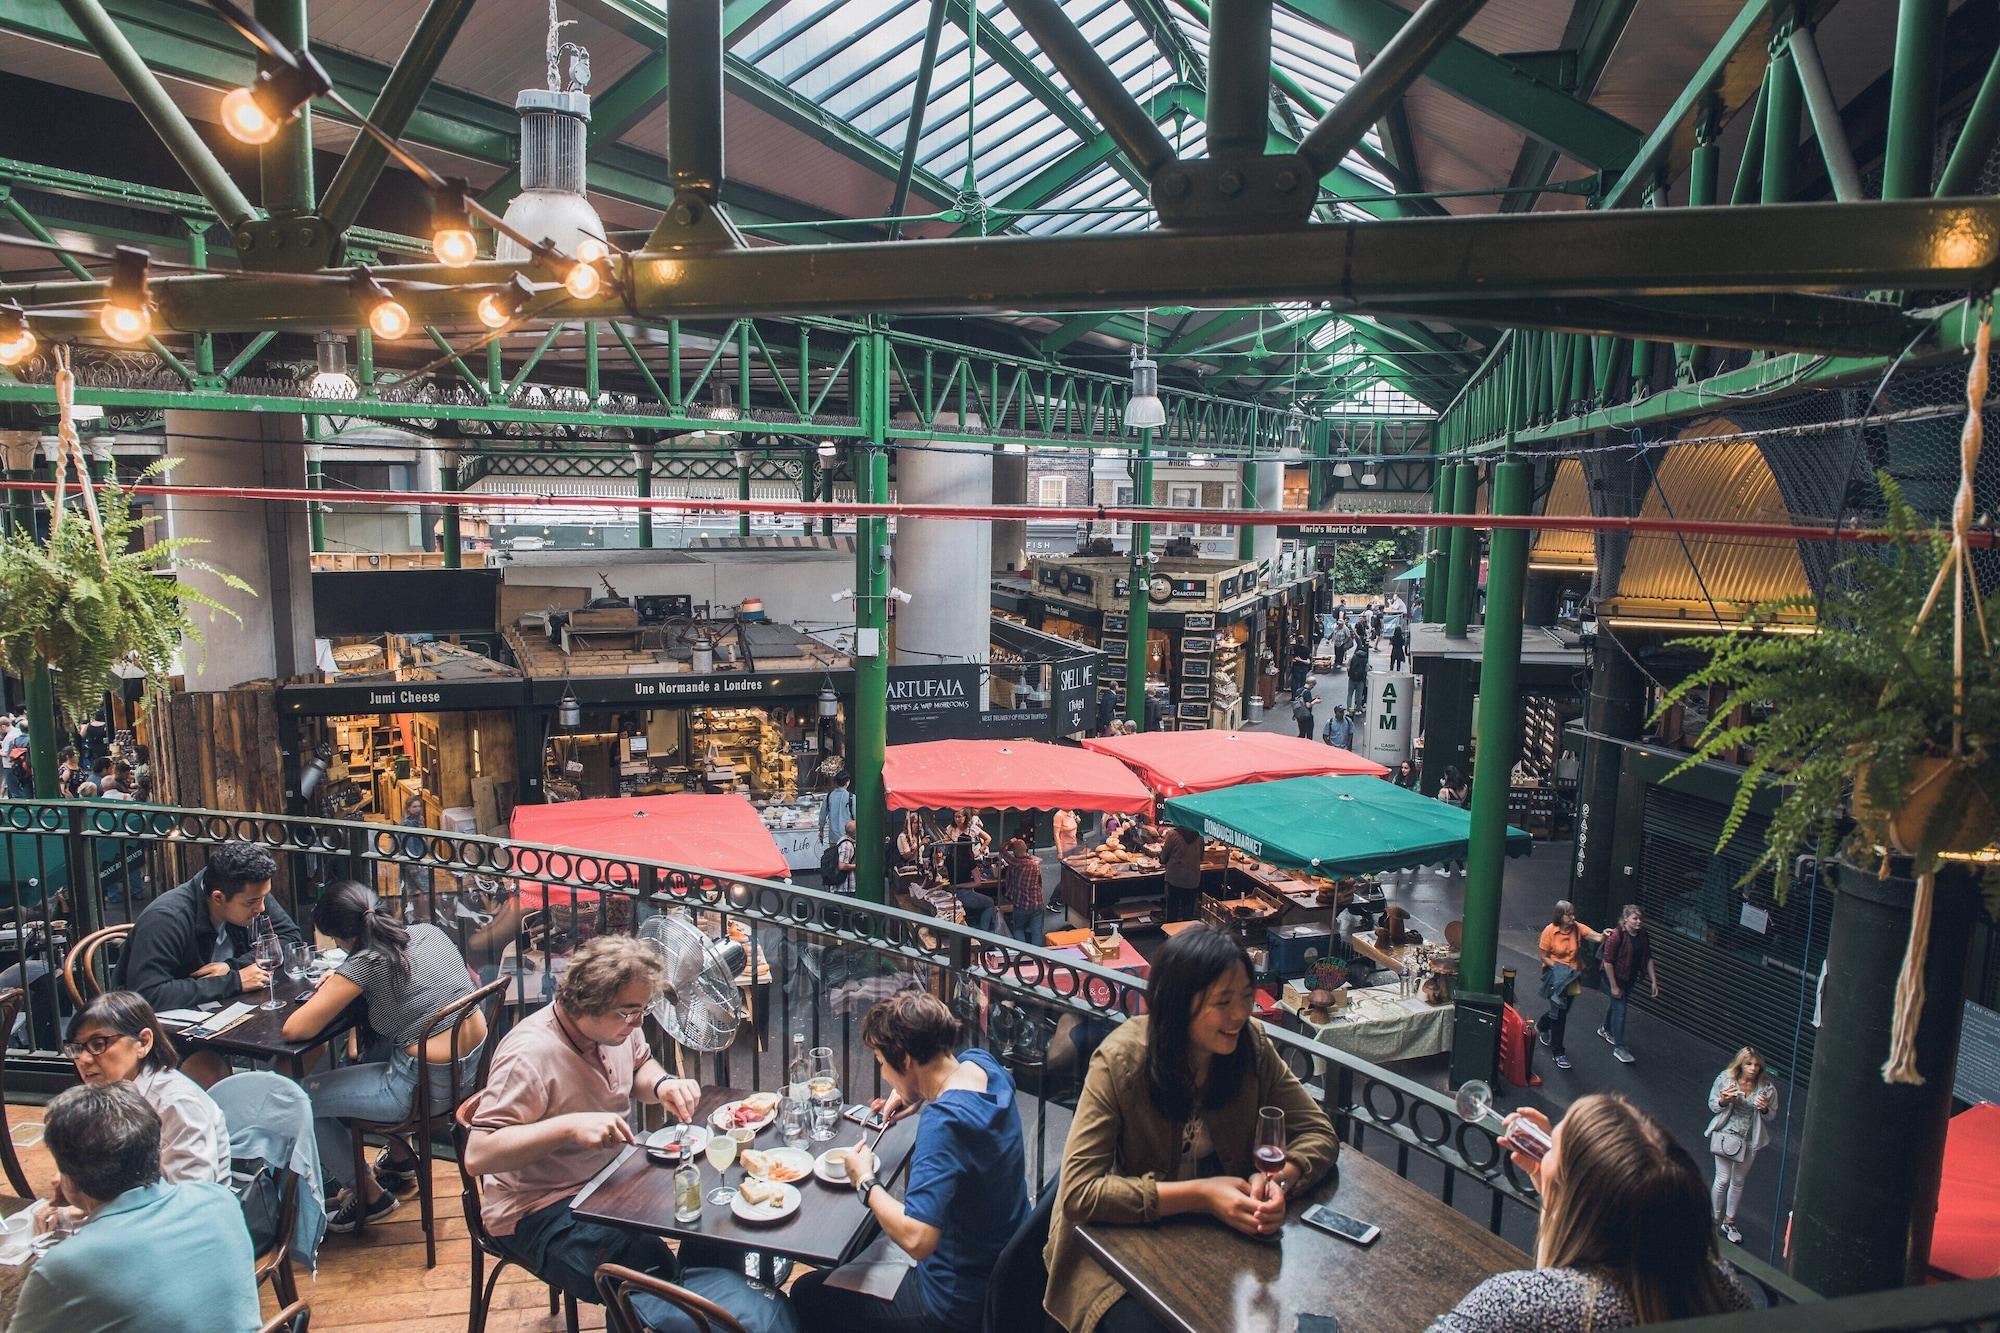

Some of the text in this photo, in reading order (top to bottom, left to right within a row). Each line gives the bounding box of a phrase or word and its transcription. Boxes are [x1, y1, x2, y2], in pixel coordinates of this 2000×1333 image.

[1326, 525, 1350, 535] Market
[1351, 525, 1368, 535] Café
[635, 679, 763, 695] Une Normande a Londres
[885, 679, 964, 699] ARTUFAIA
[369, 690, 440, 705] Jumi Cheese
[1379, 682, 1398, 731] ATM
[1204, 818, 1263, 856] BOROUGH MARKET
